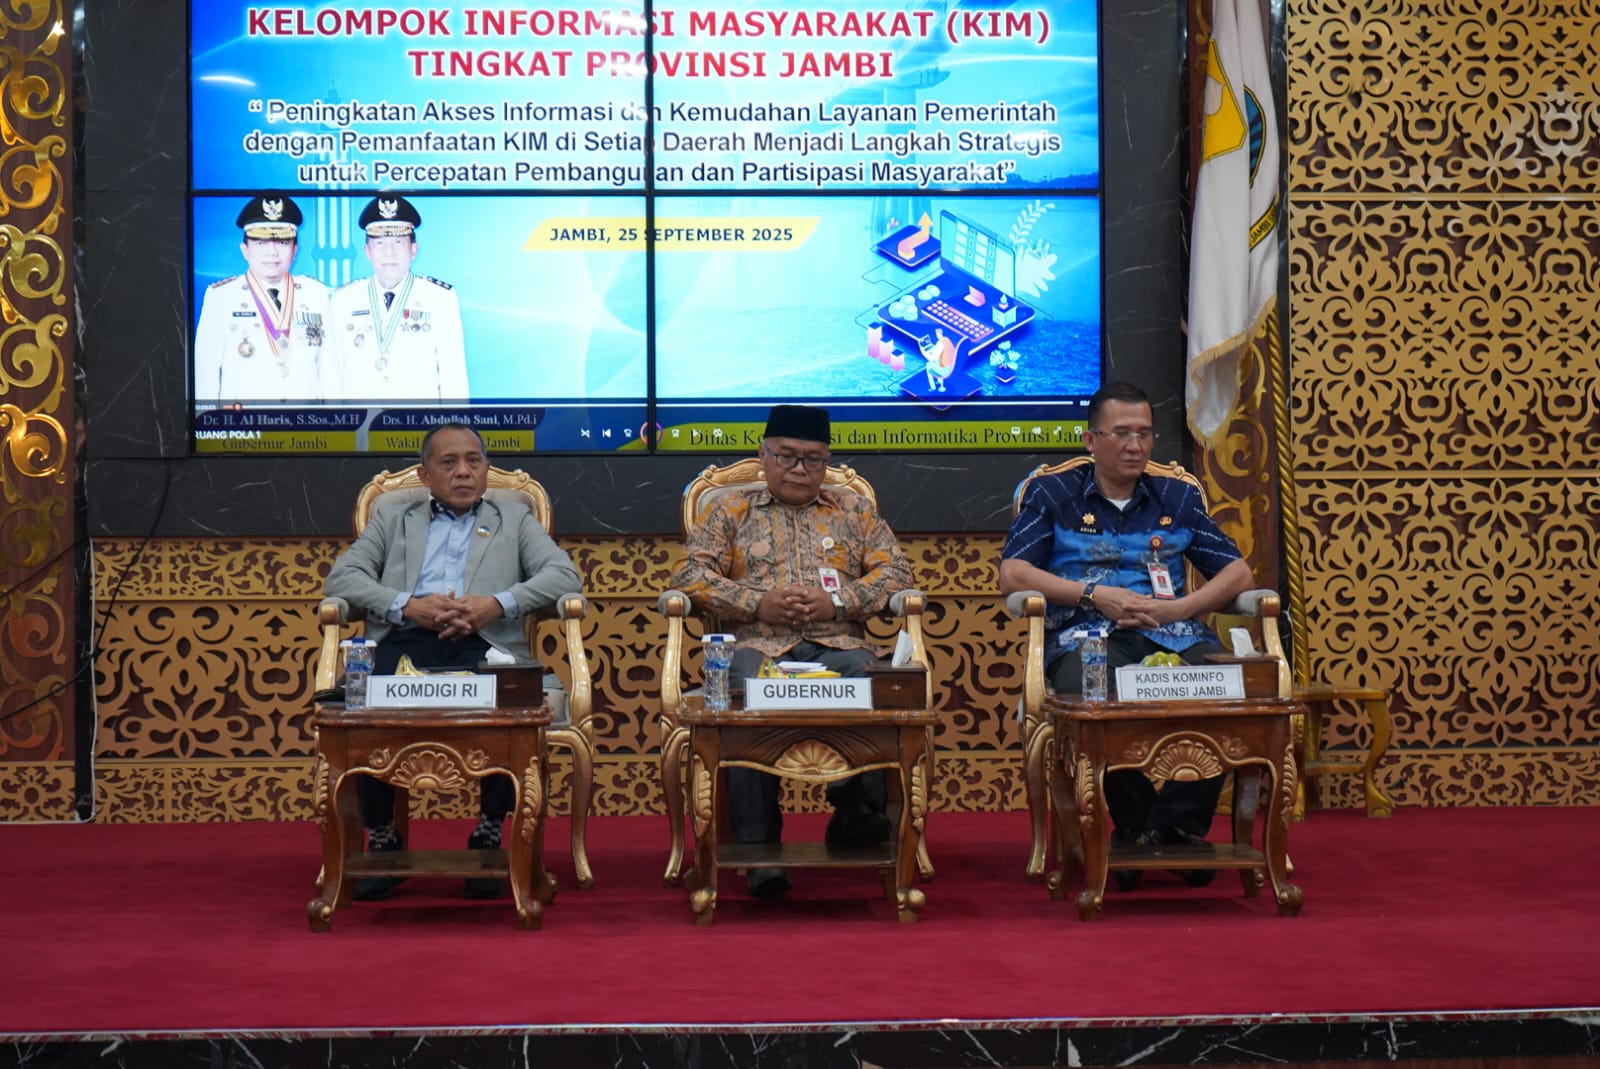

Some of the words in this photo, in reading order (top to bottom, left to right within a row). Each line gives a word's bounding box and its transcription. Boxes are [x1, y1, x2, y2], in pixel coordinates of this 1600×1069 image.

[248, 9, 450, 36] KELOMPOK
[464, 10, 675, 36] INFORMASI
[689, 11, 934, 37] MASYARAKAT
[946, 11, 1050, 43] (KIM)
[408, 51, 573, 77] TINGKAT
[587, 51, 767, 77] PROVINSI
[779, 52, 893, 77] JAMBI
[268, 101, 416, 125] Peningkatan
[422, 102, 496, 122] Akses
[502, 101, 613, 121] Informasi
[670, 102, 811, 121] Kemudahan
[818, 102, 917, 127] Layanan
[925, 102, 1056, 122] Pemerintah
[244, 131, 334, 155] dengan
[342, 131, 496, 151] Pemanfaatan
[504, 132, 547, 151] KIM
[555, 131, 576, 151] di
[584, 131, 655, 155] Setia
[663, 131, 746, 151] Daerah
[753, 131, 844, 156] Menjadi
[851, 131, 950, 156] Langkah
[958, 131, 1061, 156] Strategis
[299, 161, 367, 182] untuk
[374, 161, 506, 186] Percepatan
[515, 161, 683, 186] Pembanguan
[691, 161, 735, 182] dan
[742, 161, 864, 186] Partisipasi
[550, 228, 611, 243] JAMBI,
[618, 228, 637, 241] 25
[644, 228, 745, 241] EPTEMBER
[752, 228, 793, 241] 2025
[203, 414, 219, 425] Dr.
[224, 414, 236, 425] H.
[240, 414, 254, 425] Al
[257, 414, 293, 427] Haris,
[382, 414, 402, 425] Drs.
[407, 414, 418, 425] H.
[421, 414, 471, 425] Abdullah
[473, 414, 500, 426] Sani,
[503, 413, 537, 425] M.Pd.i
[229, 430, 255, 439] POLA
[847, 428, 876, 445] dan
[883, 428, 978, 445] Informatika
[984, 427, 1050, 444] Provinsi
[222, 436, 285, 449] Gubernur
[289, 436, 328, 449] Jambi
[386, 436, 420, 449] Wakil
[485, 436, 521, 449] Jambi
[1135, 672, 1169, 684] KADIS
[1172, 671, 1225, 684] KOMINFO
[386, 683, 457, 698] KOMDIGI
[462, 683, 478, 698] RI
[763, 684, 856, 699] GUBERNUR
[1136, 687, 1189, 698] PROVINSI
[1192, 686, 1227, 697] JAMBI
